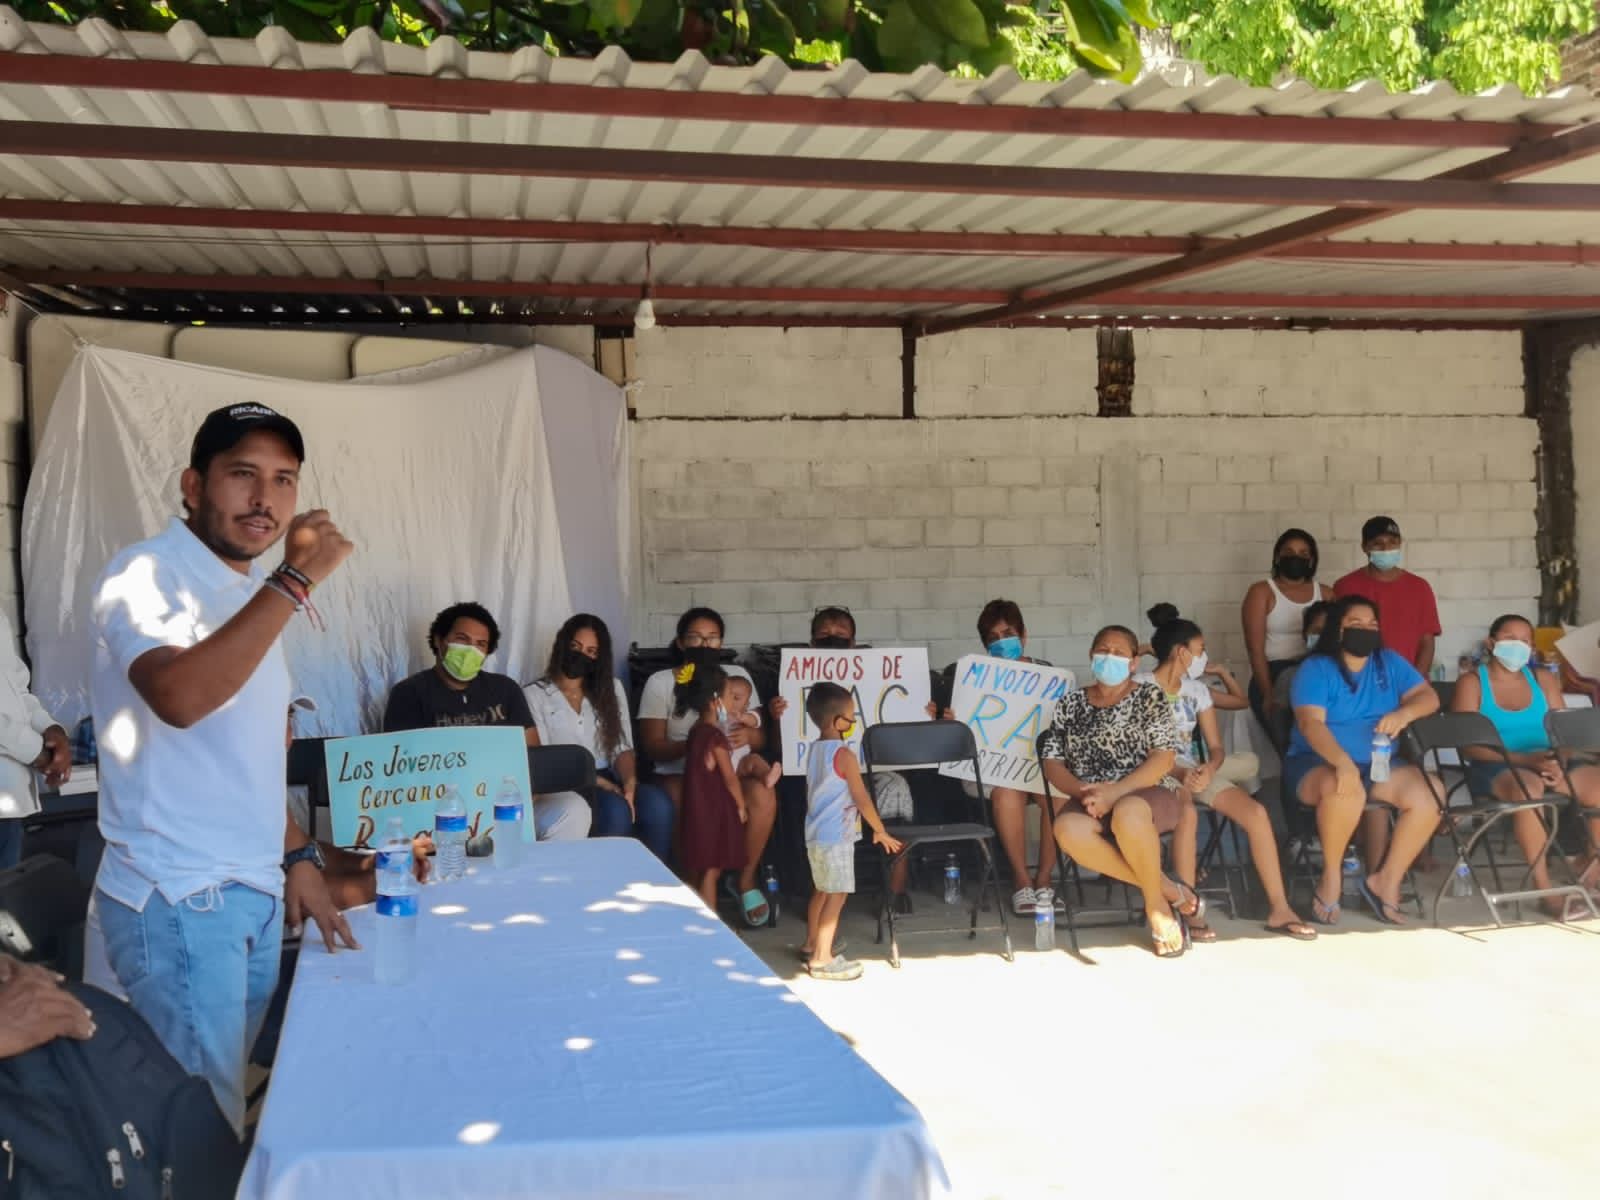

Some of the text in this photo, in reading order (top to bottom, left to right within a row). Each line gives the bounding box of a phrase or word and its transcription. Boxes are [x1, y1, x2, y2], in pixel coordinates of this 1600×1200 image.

[786, 655, 903, 681] AMIGOS DE
[962, 662, 990, 688] MI
[993, 665, 1041, 695] VOTO
[338, 745, 468, 782] Los Jóvenes
[476, 780, 488, 797] a
